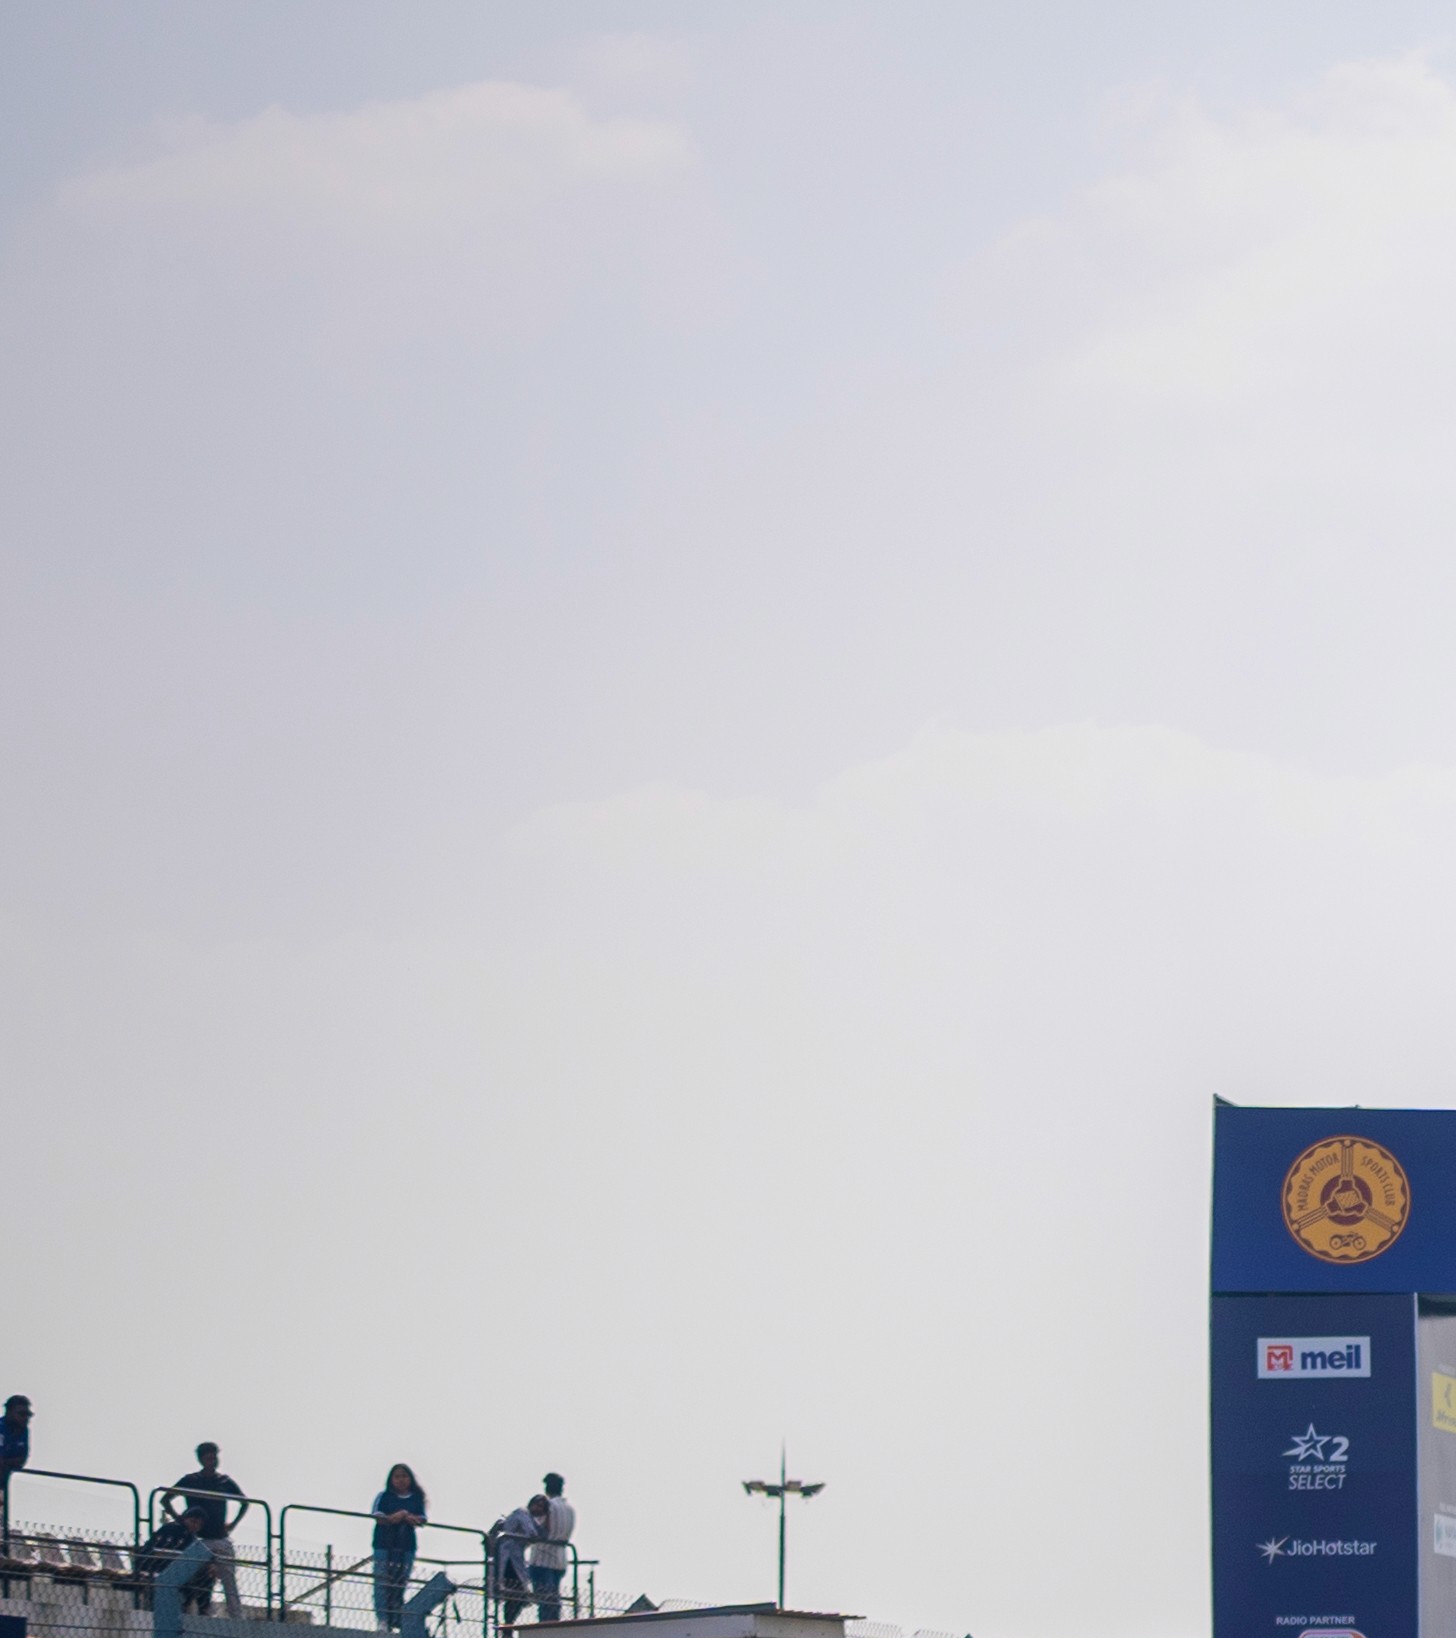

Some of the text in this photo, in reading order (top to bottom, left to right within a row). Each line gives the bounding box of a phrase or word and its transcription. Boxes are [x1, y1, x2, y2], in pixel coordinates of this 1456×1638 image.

[1301, 1344, 1361, 1370] meil
[1329, 1436, 1349, 1462] 2
[1290, 1465, 1346, 1473] STAR SPORTS
[1289, 1474, 1346, 1490] SELECT
[1287, 1540, 1377, 1556] JioHotstar
[1276, 1616, 1355, 1625] RADIO PARTNER
